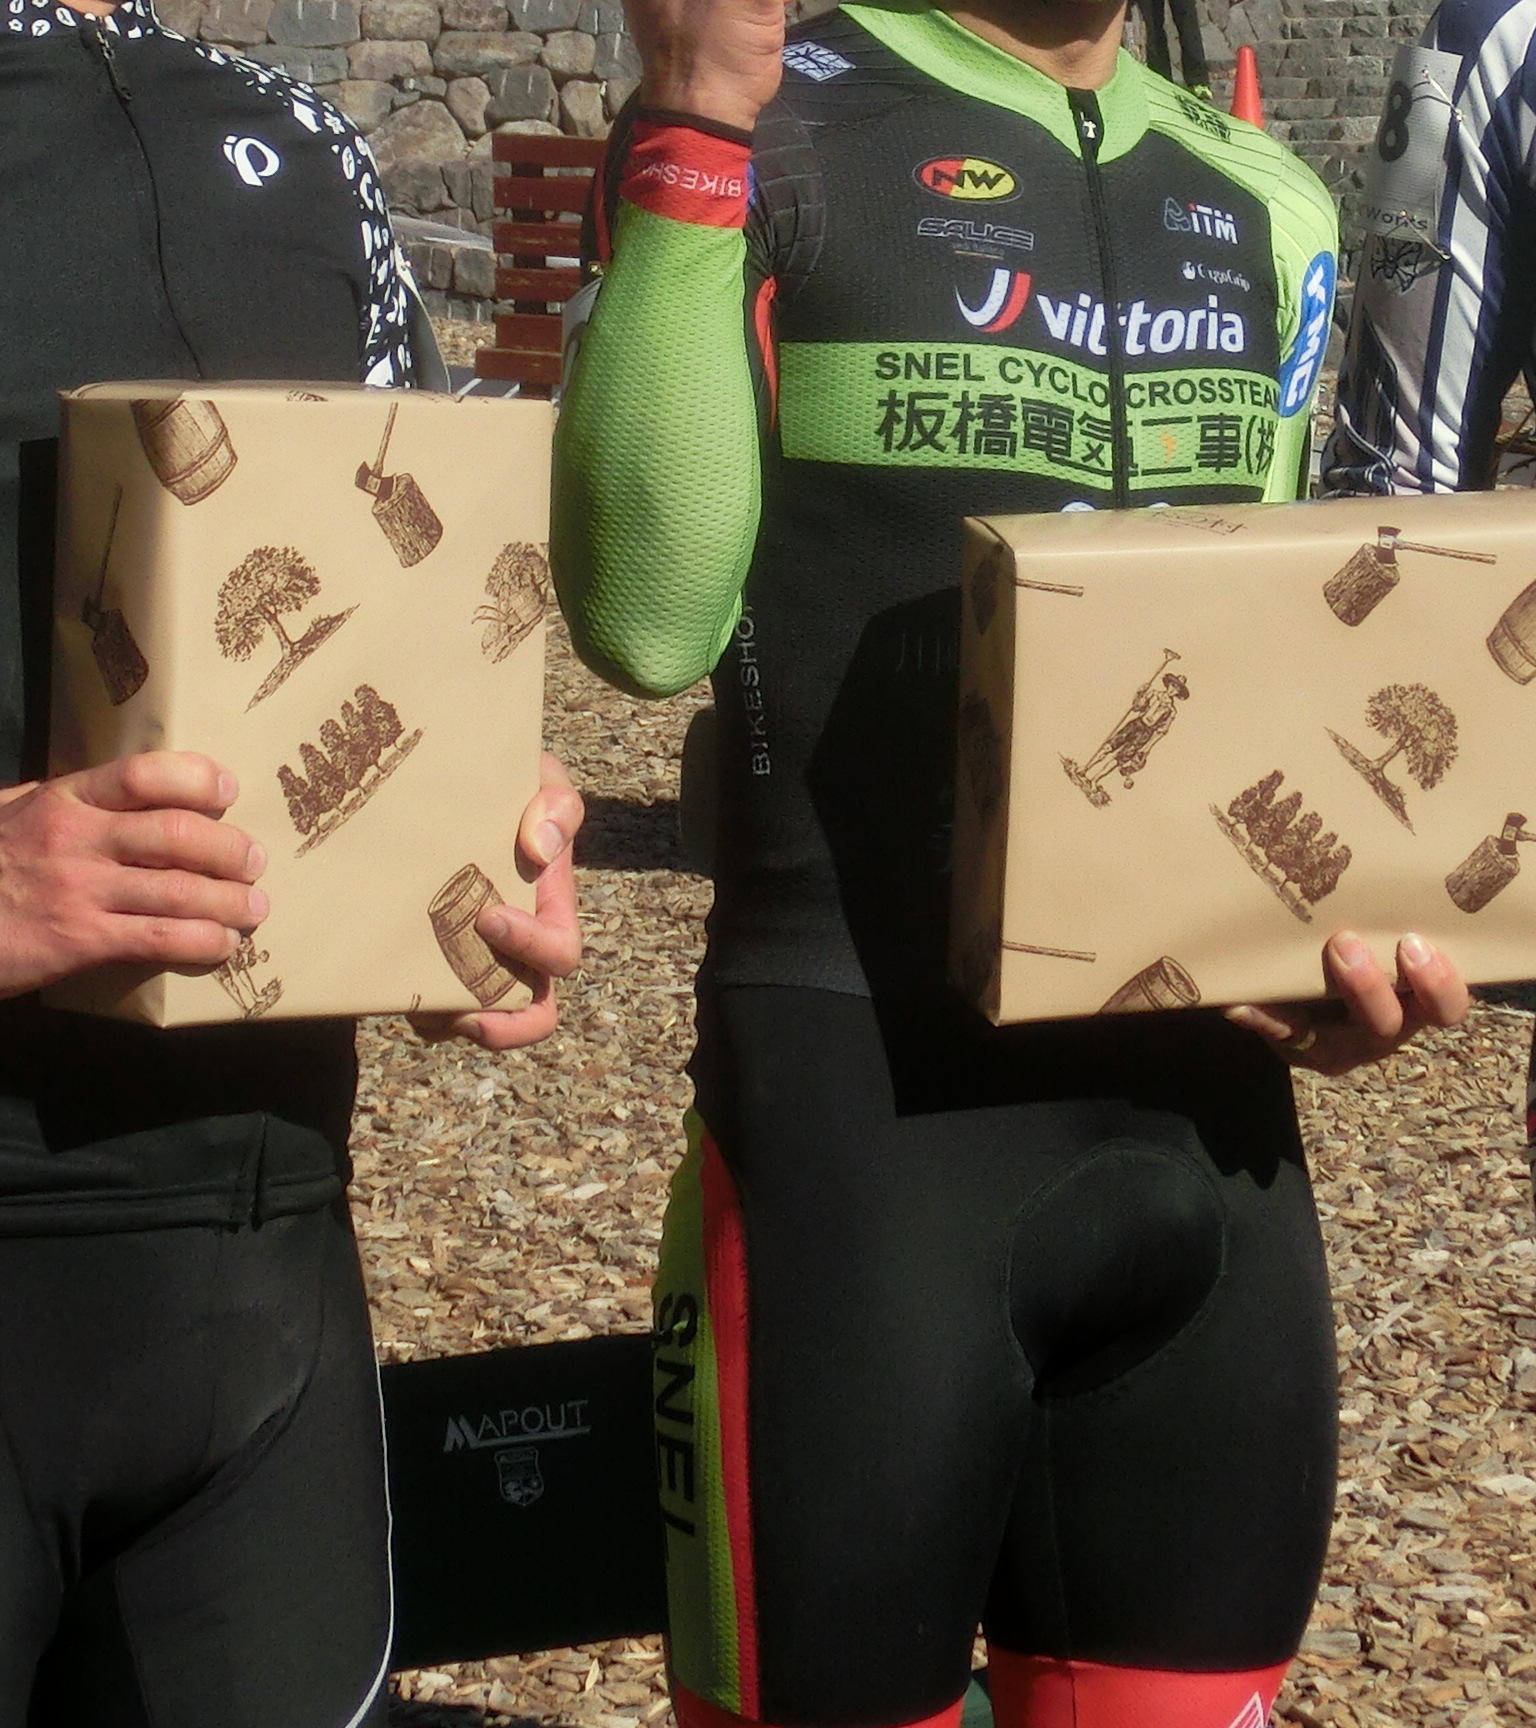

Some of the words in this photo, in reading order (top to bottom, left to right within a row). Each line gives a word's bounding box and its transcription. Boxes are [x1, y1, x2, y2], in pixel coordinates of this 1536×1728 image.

[642, 161, 743, 198] BIKESH
[932, 167, 1006, 191] NW
[1036, 292, 1244, 356] vittoria
[875, 352, 986, 381] SNEL
[998, 357, 1109, 409] CYCLO
[444, 1399, 589, 1452] MAPOUT
